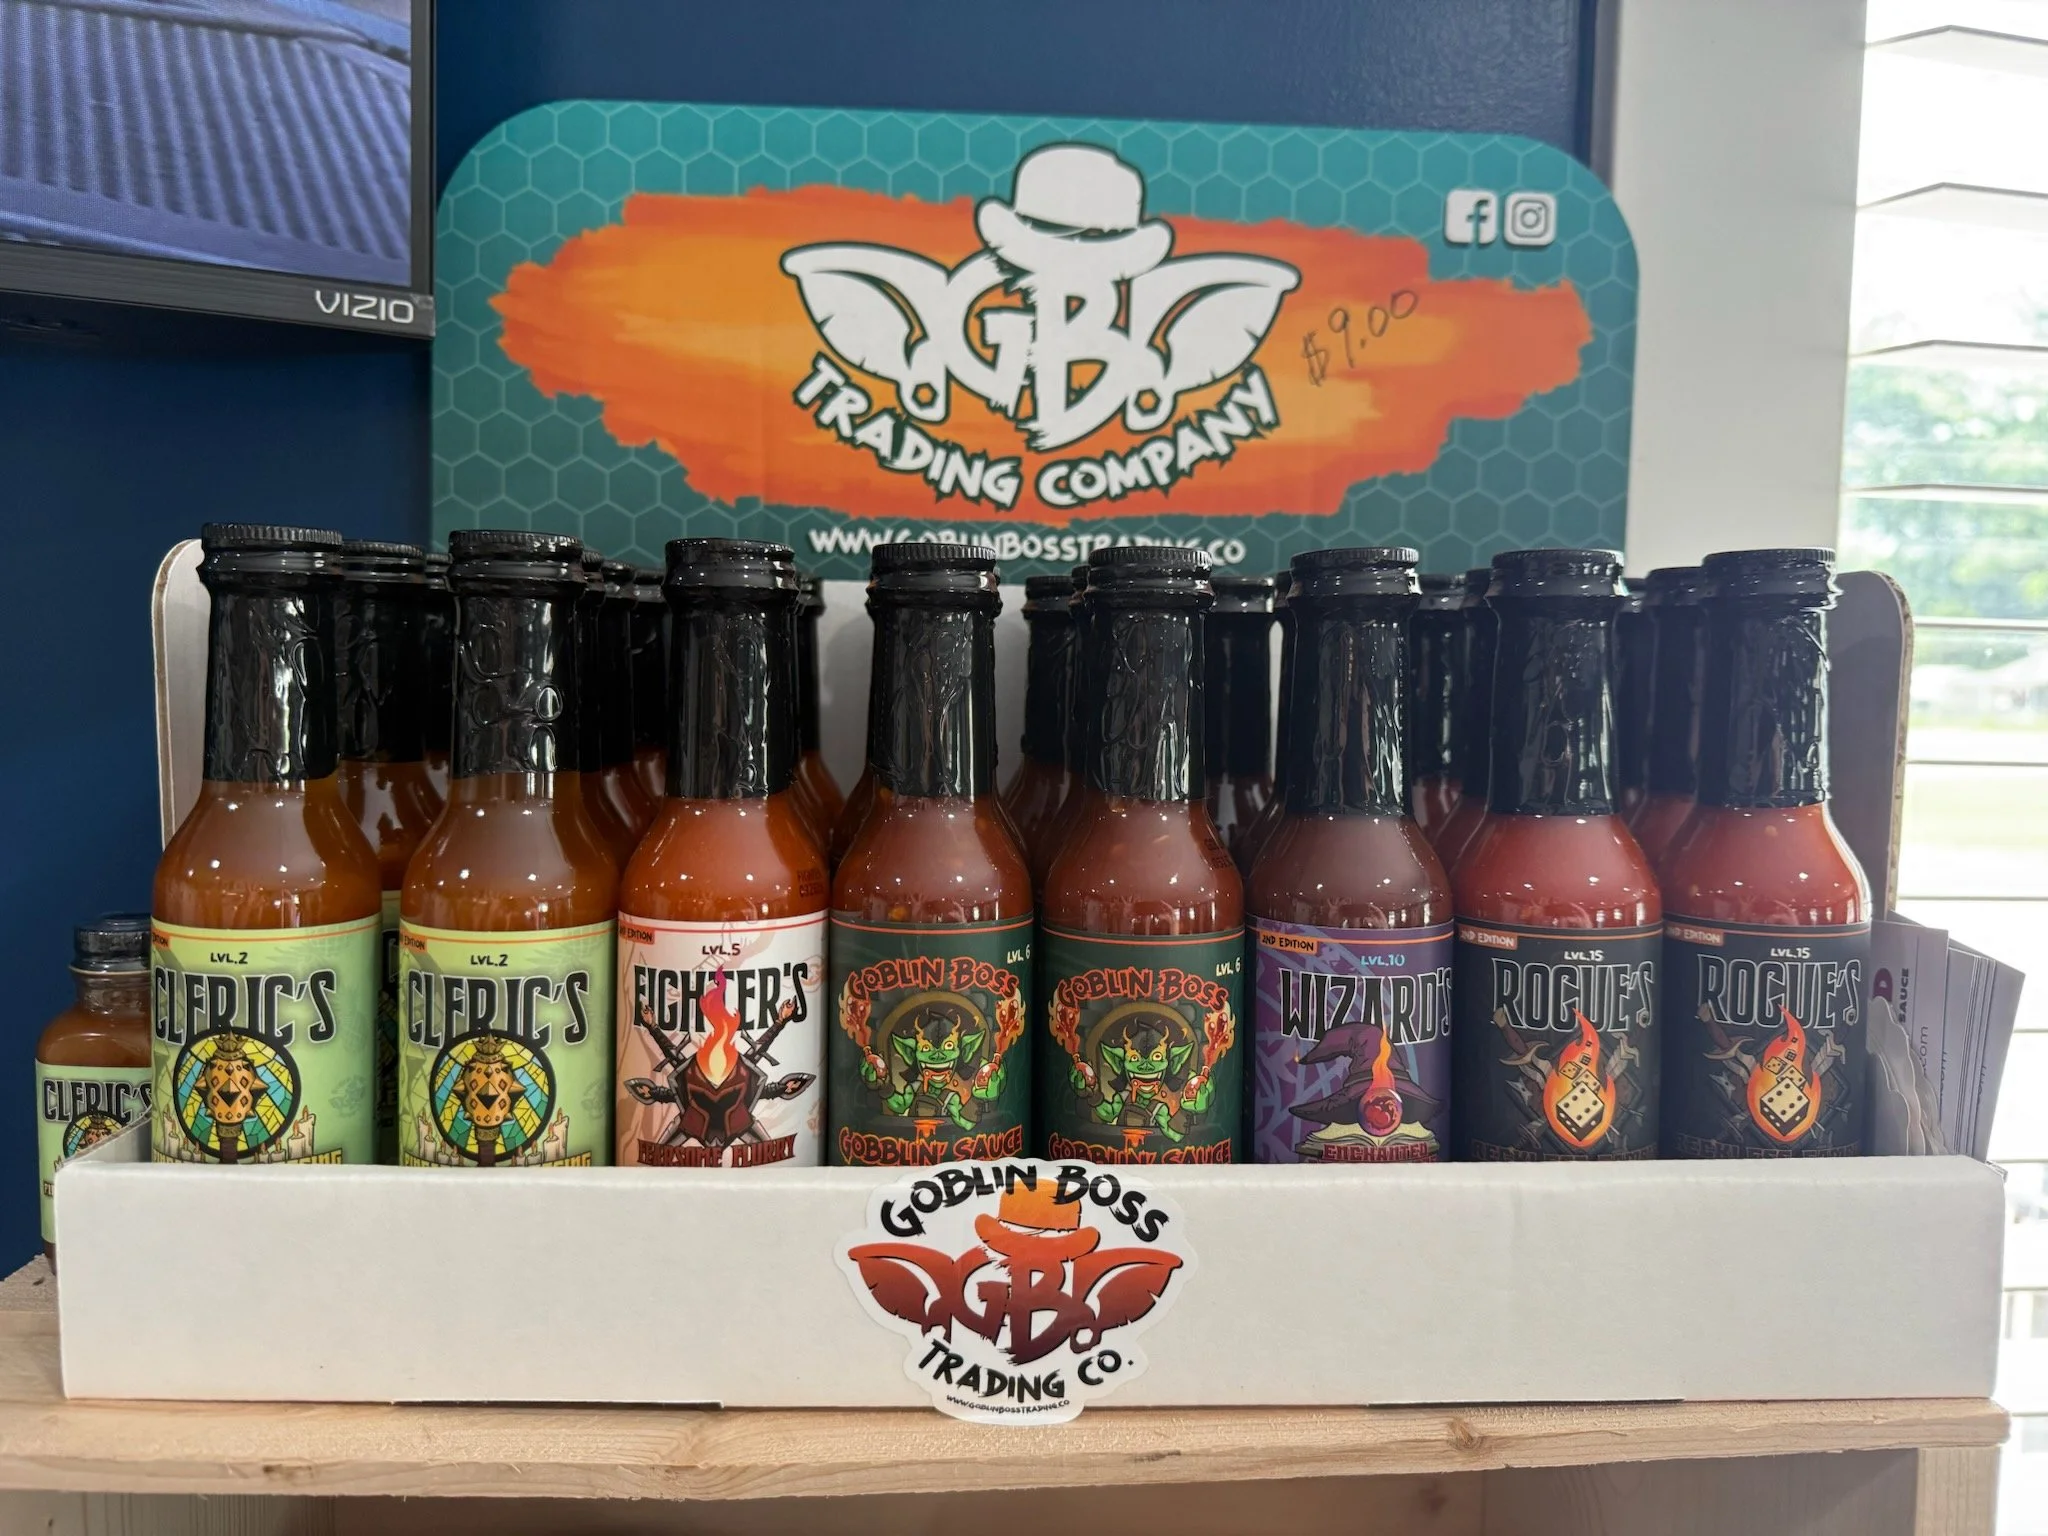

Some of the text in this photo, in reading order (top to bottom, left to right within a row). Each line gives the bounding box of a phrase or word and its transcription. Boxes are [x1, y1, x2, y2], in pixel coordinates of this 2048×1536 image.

[316, 290, 414, 324] VIZIO
[1301, 290, 1417, 387] $9.00
[797, 358, 1276, 503] TRADING COMPANY
[702, 943, 741, 956] LVL.5
[1279, 937, 1314, 951] EDITION
[1478, 932, 1515, 947] EDITION
[1684, 929, 1721, 943] EDITION
[1771, 947, 1811, 959] LVL.15
[210, 952, 249, 965] LVL.2
[470, 954, 509, 967] LVL.2
[1361, 954, 1405, 967] LVL.10
[1564, 950, 1605, 962] LVL.15
[634, 962, 808, 1032] FIGHTER'S
[848, 957, 1020, 1002] GOBLIN BOSS
[1058, 967, 1231, 1012] GOBLIN BOSS
[1492, 957, 1655, 1033] ROGUE'S
[1696, 954, 1861, 1029] ROGUE'S
[1899, 967, 1910, 1023] SAUCE
[155, 965, 337, 1046] CLERIC'S
[407, 970, 590, 1050] CLERIC'S
[731, 1133, 798, 1168] FLURRY
[953, 1124, 1023, 1161] SAUCE
[1323, 1142, 1429, 1162] ENCHANTED
[881, 1165, 1169, 1243] GOBLIN BOSS
[918, 1339, 1065, 1403] TRADING
